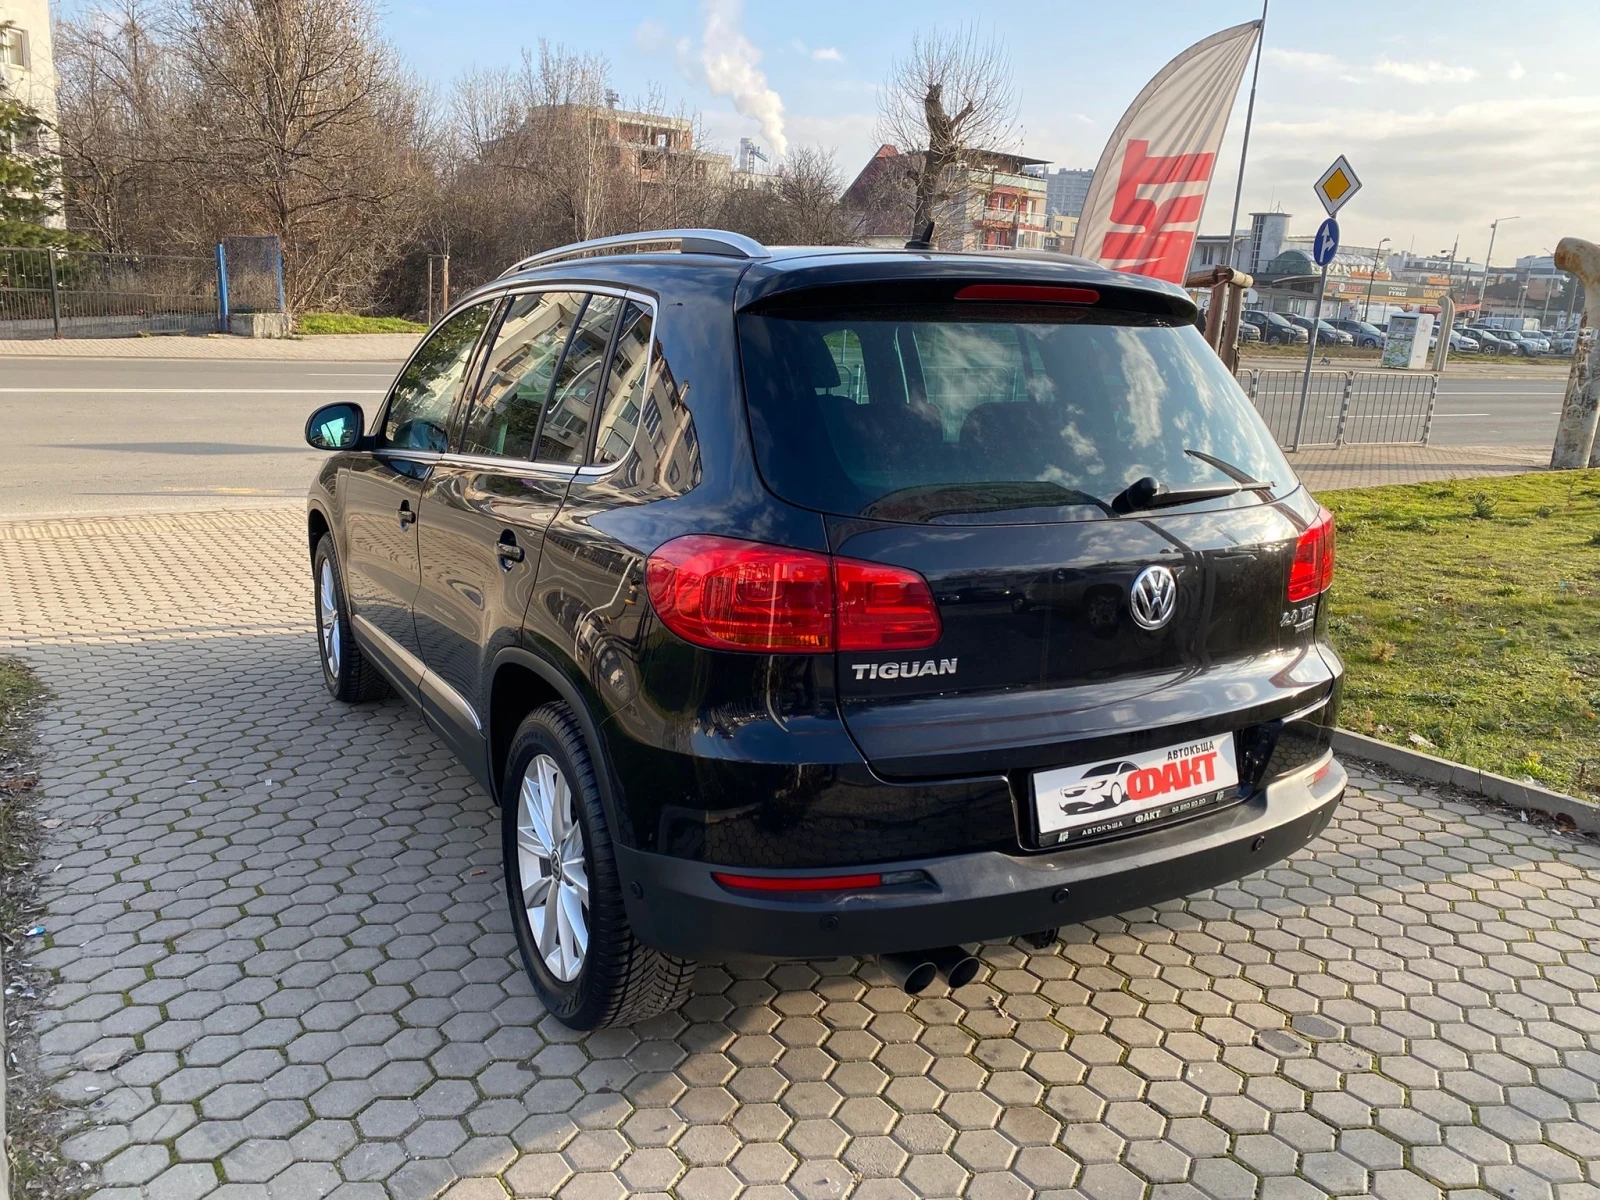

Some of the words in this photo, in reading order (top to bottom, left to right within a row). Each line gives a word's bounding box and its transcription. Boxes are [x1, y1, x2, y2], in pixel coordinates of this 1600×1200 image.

[851, 658, 958, 680] TIGUAN
[1167, 740, 1214, 761] АВТОКЪЩА
[1126, 751, 1217, 800] ФАКТ
[1135, 810, 1161, 823] ФАКТ
